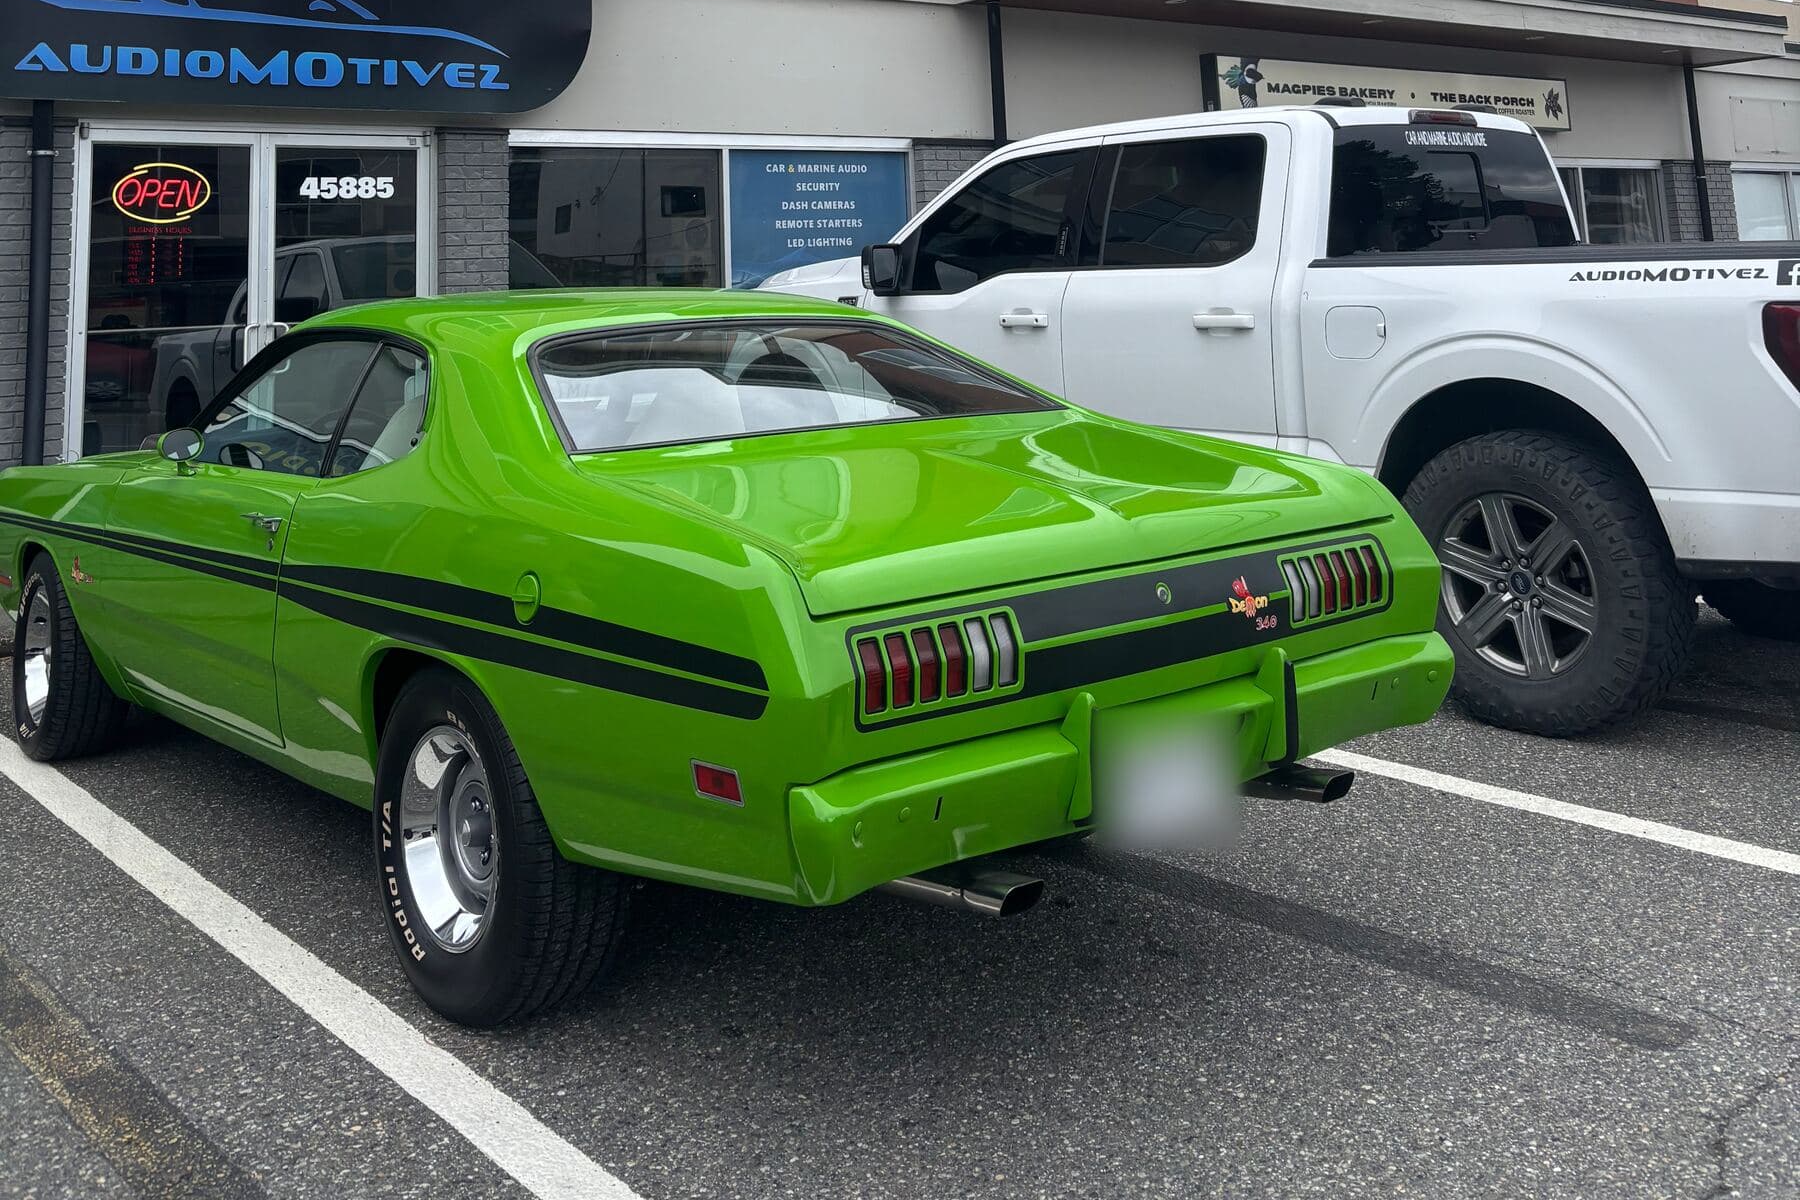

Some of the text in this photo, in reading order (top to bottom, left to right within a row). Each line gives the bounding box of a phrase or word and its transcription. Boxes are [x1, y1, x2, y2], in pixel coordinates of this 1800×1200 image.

[14, 41, 510, 90] AUDIOMOTIVEZ
[1267, 82, 1395, 99] MAGPIES BAKERY
[1430, 91, 1535, 108] THE BACK PORCH
[1405, 130, 1418, 145] CAR
[766, 164, 868, 173] CAR & MARINE AUDIO
[118, 178, 202, 207] OPEN
[300, 177, 394, 199] 45885
[796, 182, 840, 191] SECURITY
[782, 200, 856, 210] DASH CAMERAS
[775, 218, 863, 229] REMOTE STARTERS
[787, 237, 853, 248] LED LIGHTING
[1255, 614, 1278, 631] 340
[382, 800, 427, 962] Radial T/A
